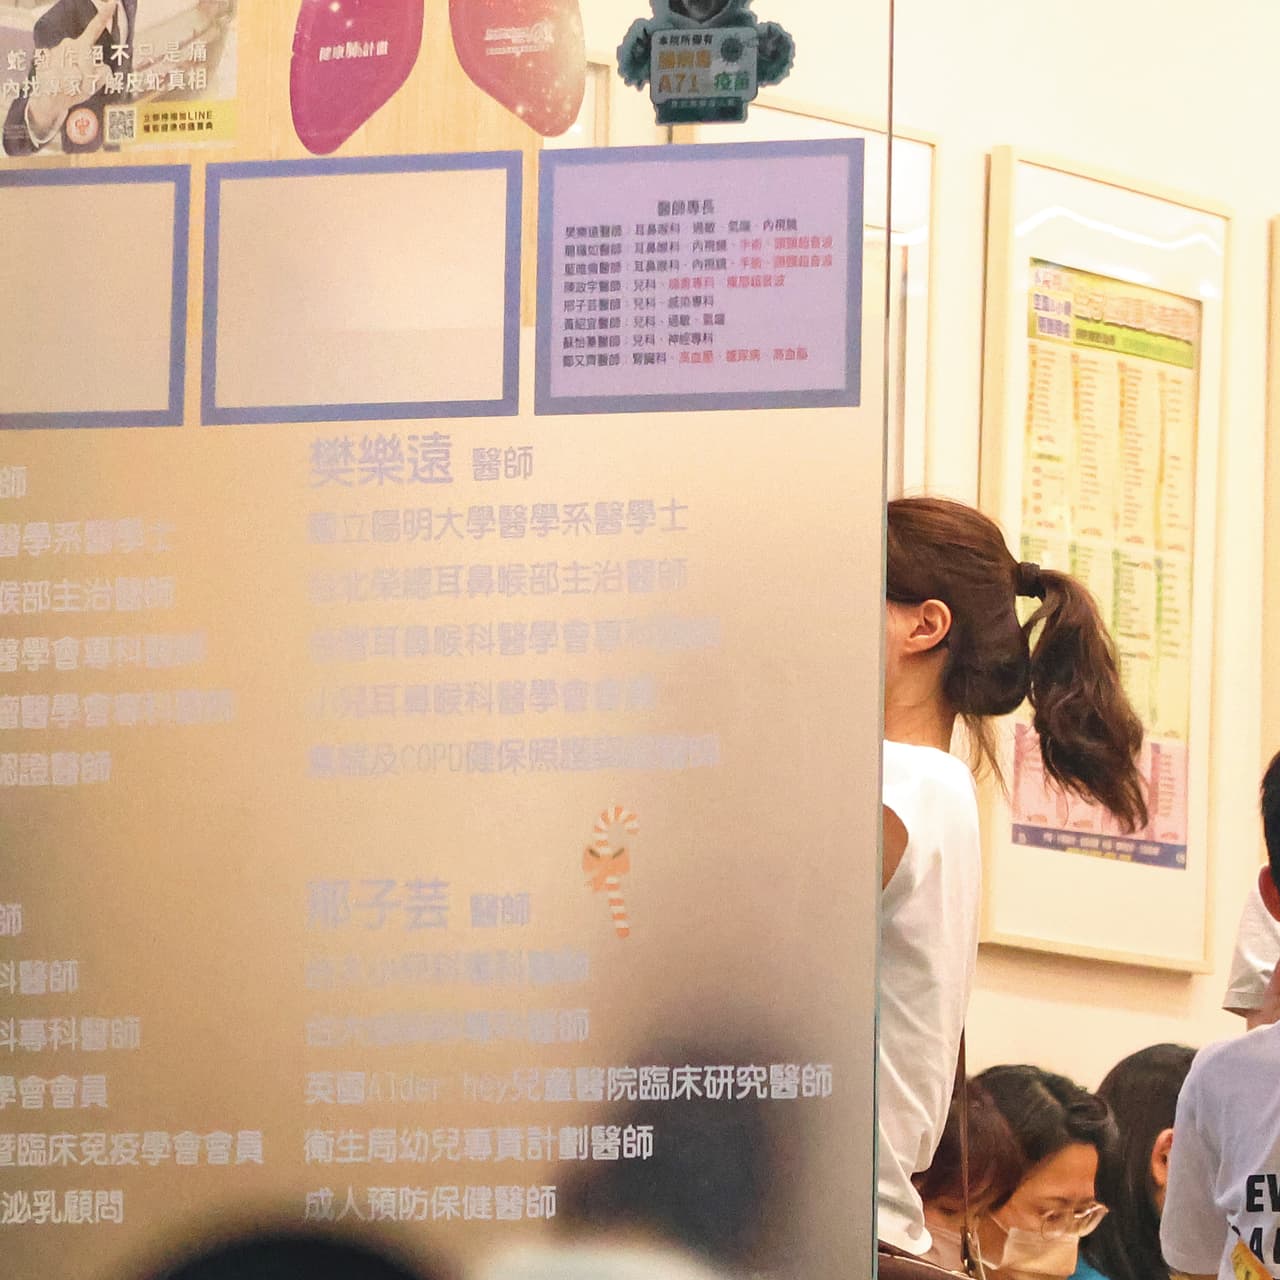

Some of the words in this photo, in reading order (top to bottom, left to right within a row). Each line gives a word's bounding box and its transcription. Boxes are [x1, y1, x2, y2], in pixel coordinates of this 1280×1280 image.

[472, 445, 534, 482] 醫師
[304, 1185, 557, 1222] 成人預防保健醫師
